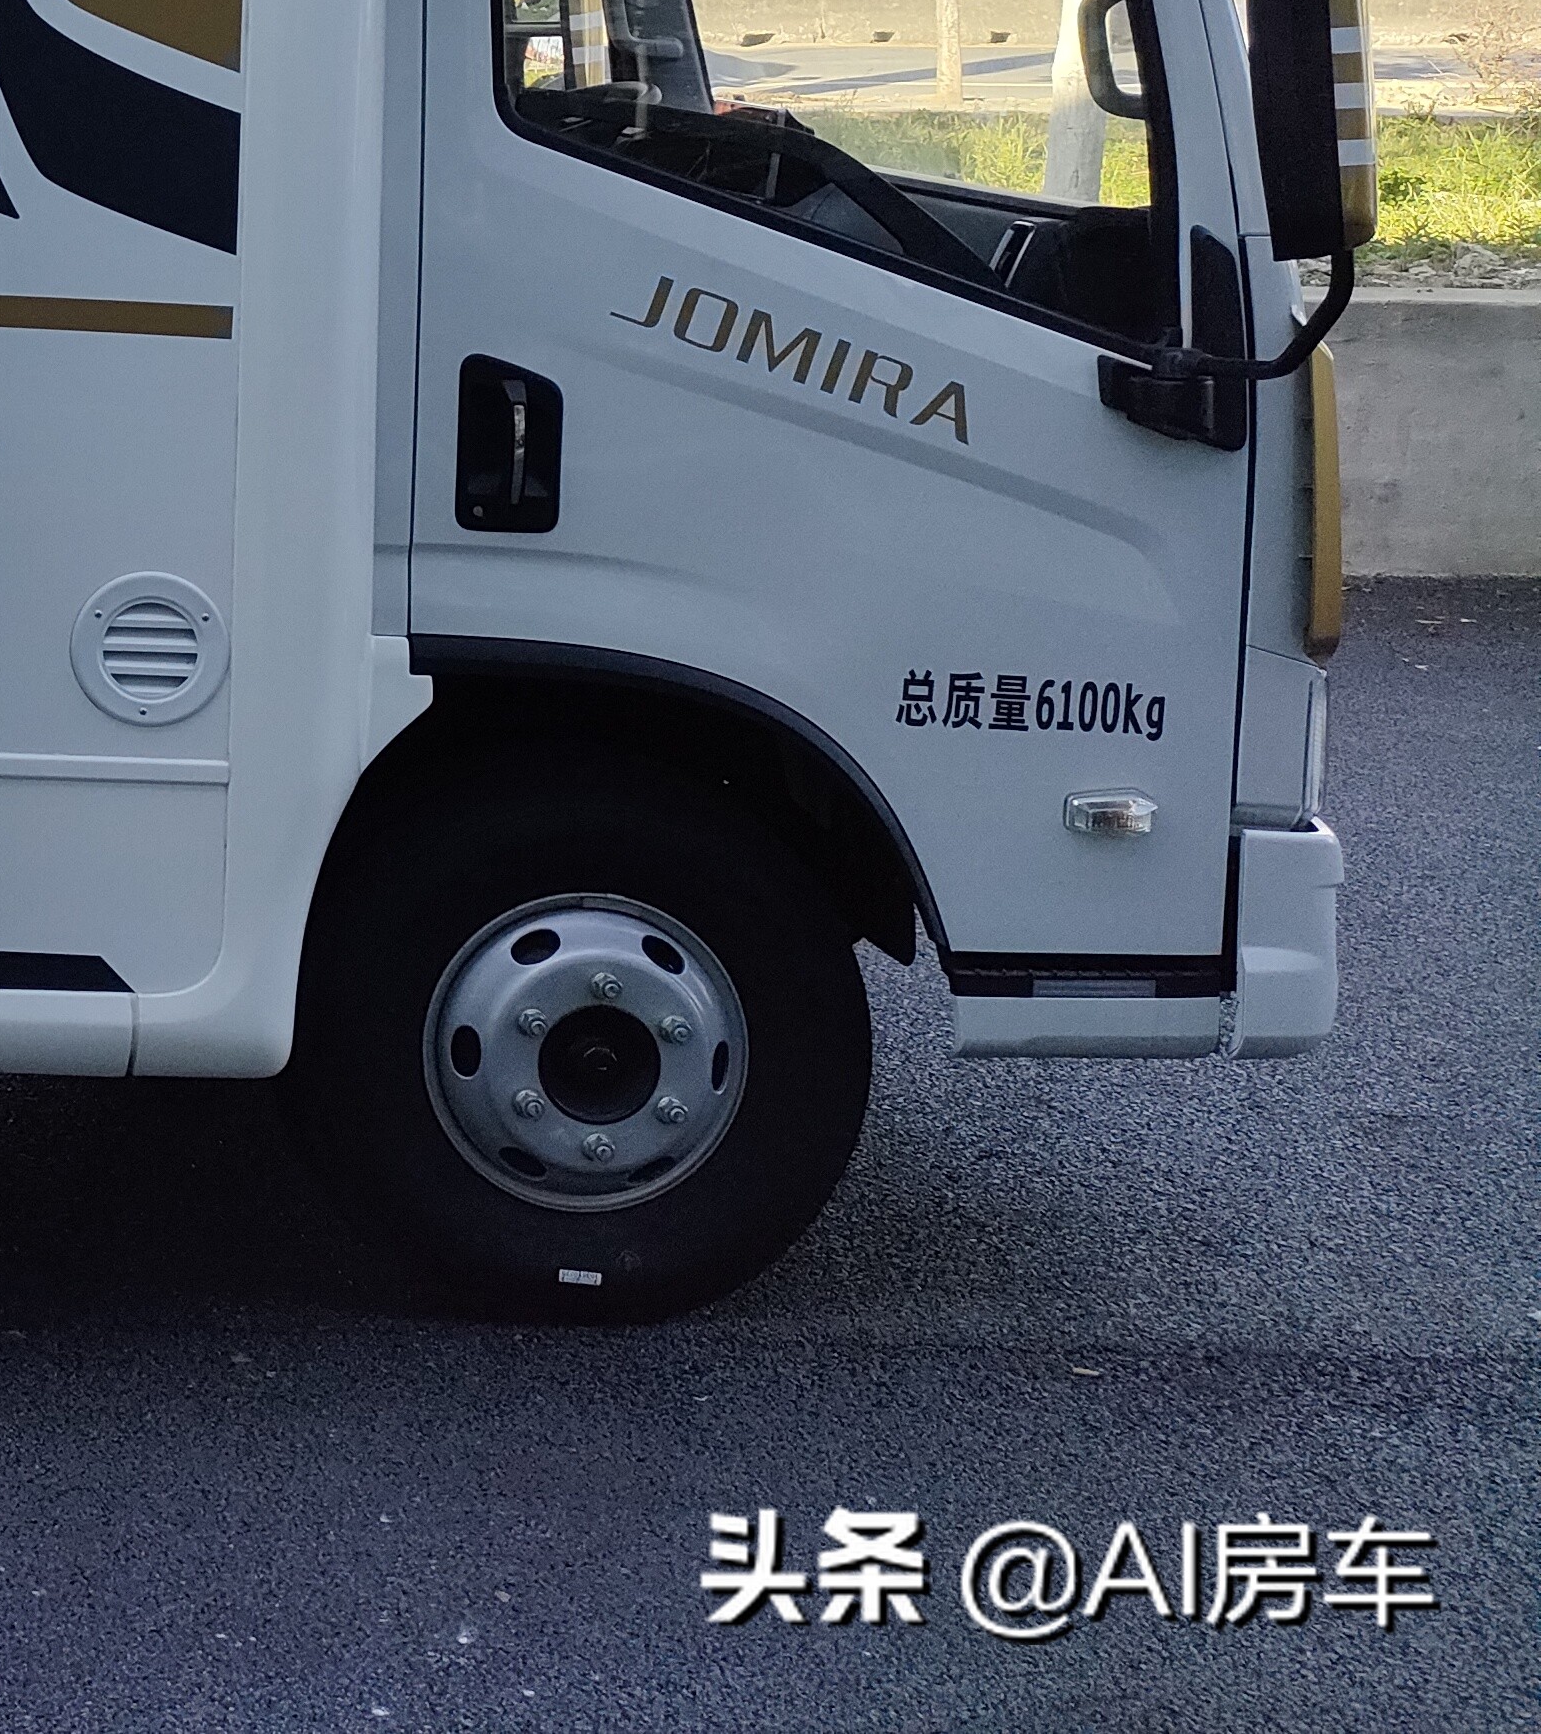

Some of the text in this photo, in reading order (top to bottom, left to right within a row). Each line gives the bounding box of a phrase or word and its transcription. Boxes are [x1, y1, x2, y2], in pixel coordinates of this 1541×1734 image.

[609, 275, 970, 446] JOMIRA
[895, 668, 1166, 742] 总质量6100kg
